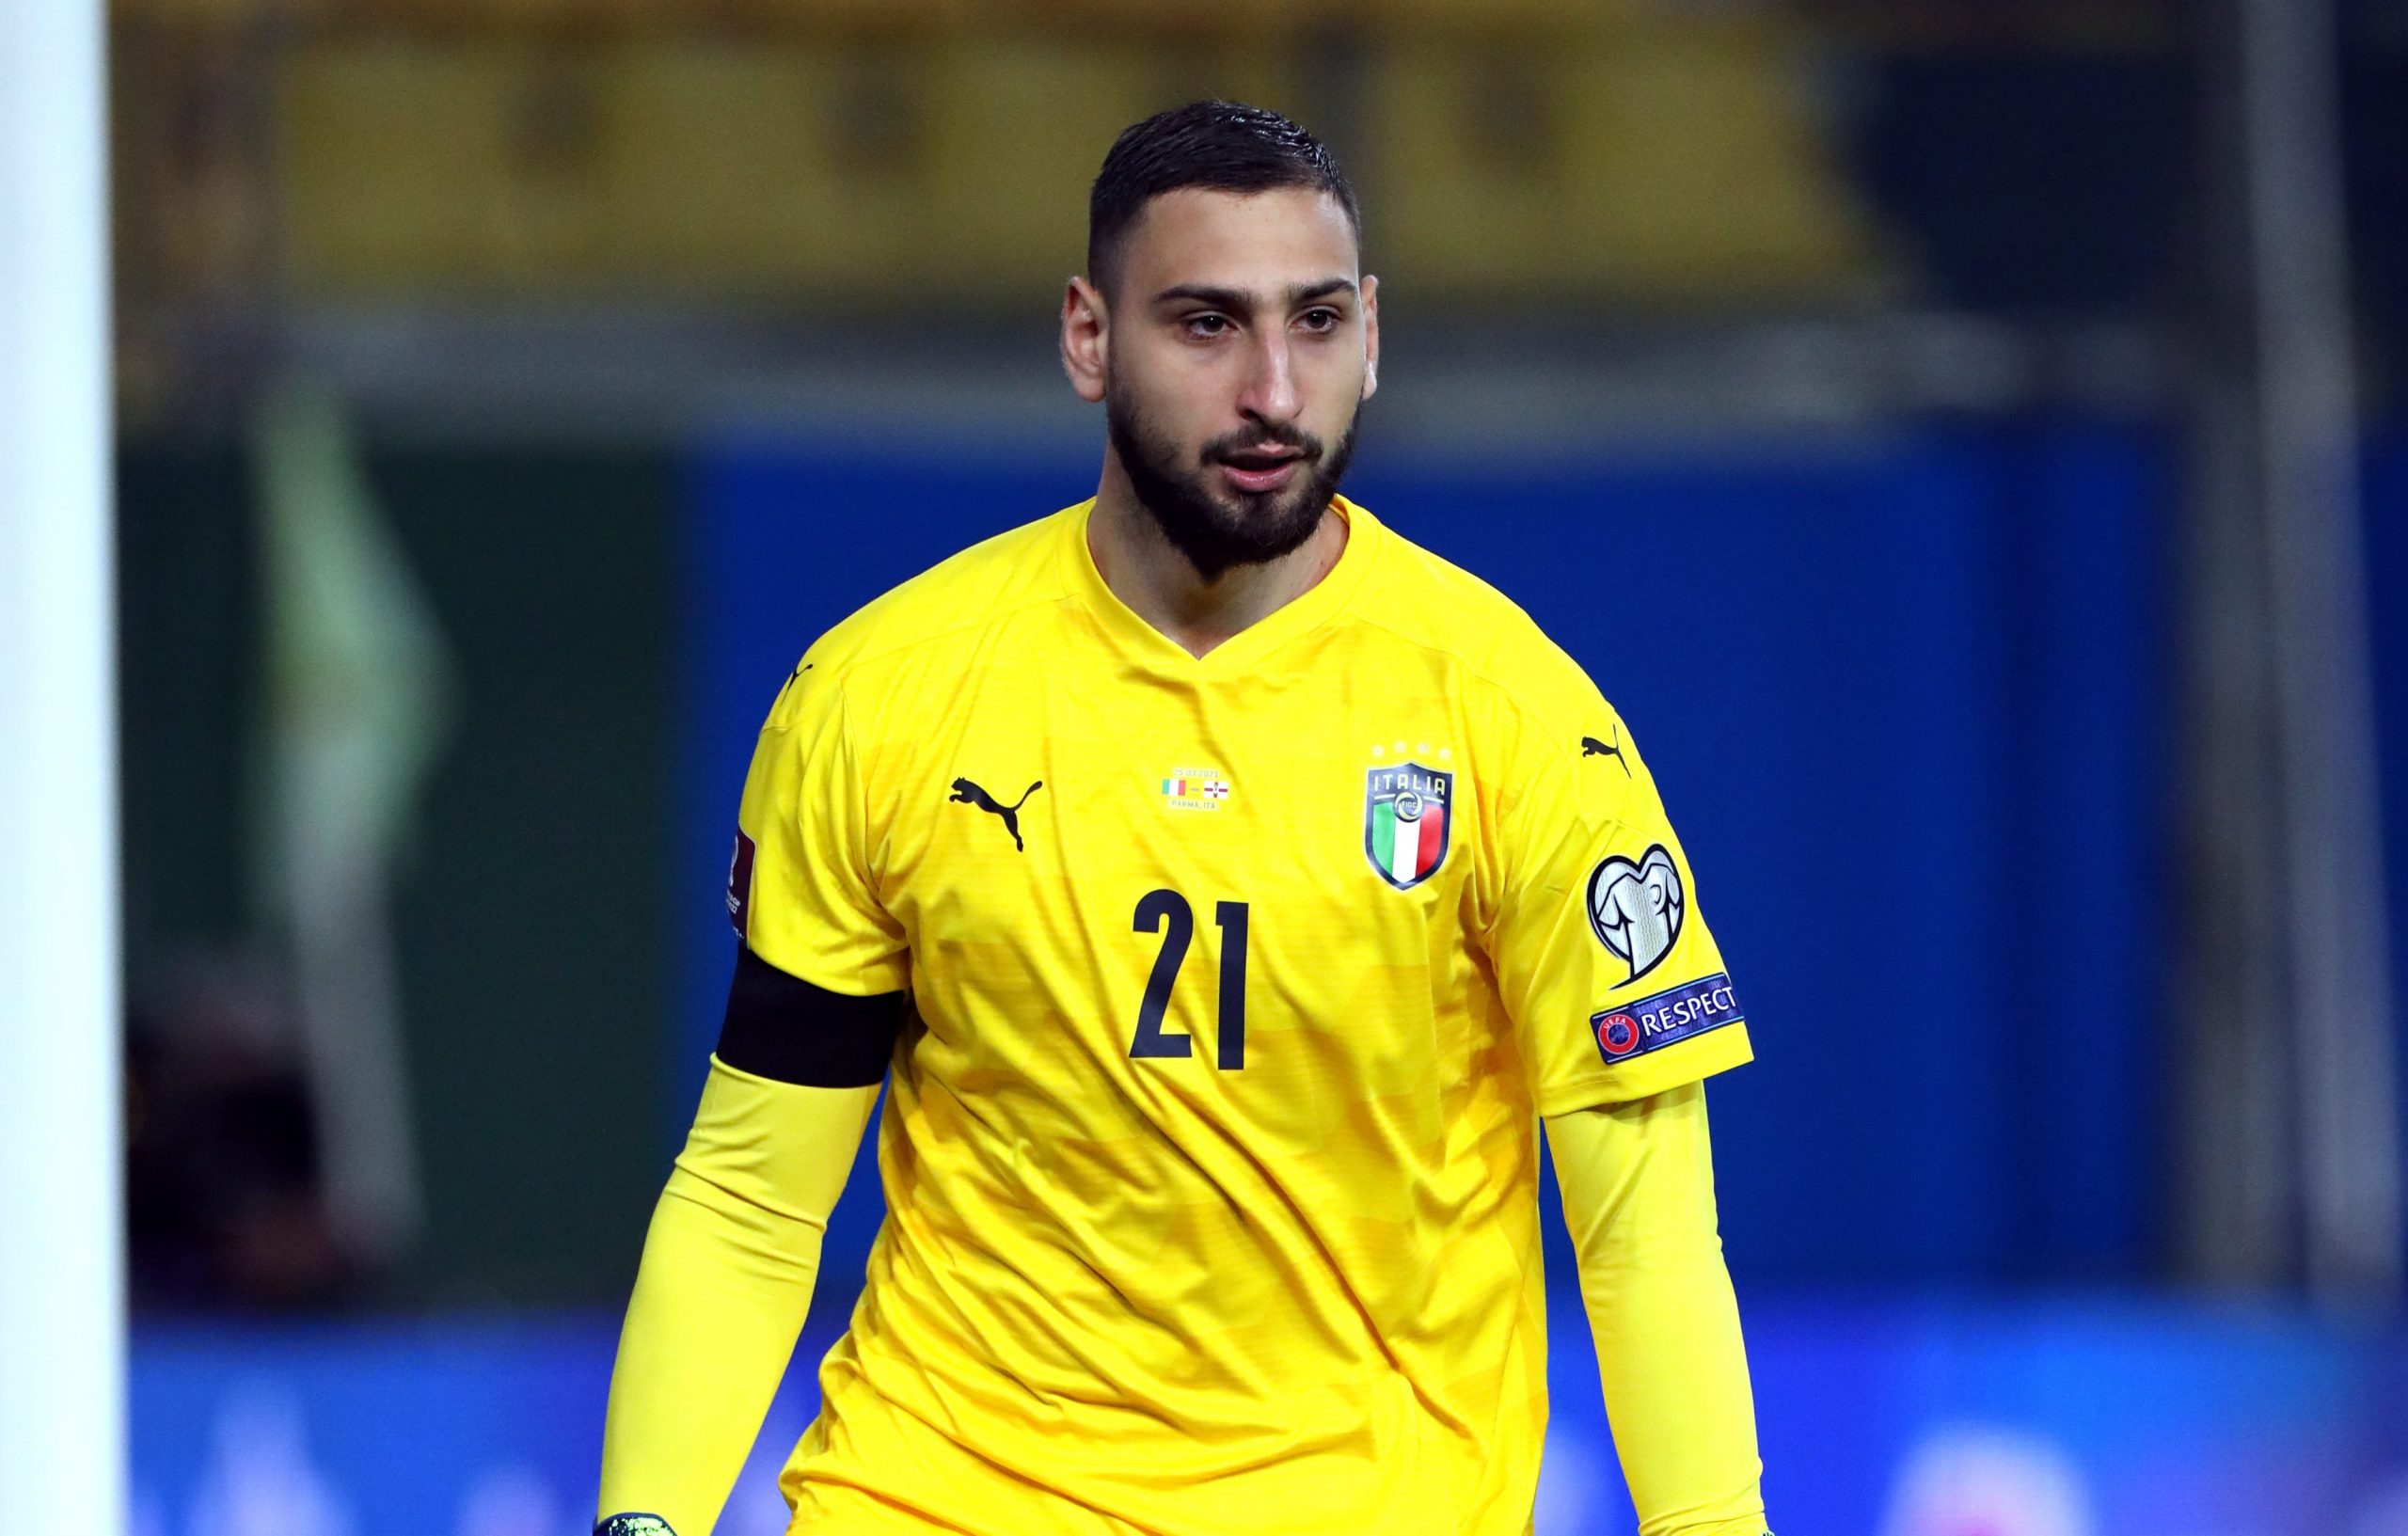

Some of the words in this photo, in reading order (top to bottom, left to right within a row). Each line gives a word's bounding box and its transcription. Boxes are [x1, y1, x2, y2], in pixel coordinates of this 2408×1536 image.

[1374, 773, 1446, 796] ITALIA
[1203, 801, 1215, 810] ITA
[1402, 800, 1417, 809] FIGC
[1129, 889, 1248, 1070] 21
[1640, 987, 1736, 1037] RESPECT
[1603, 1017, 1626, 1030] UEFA
